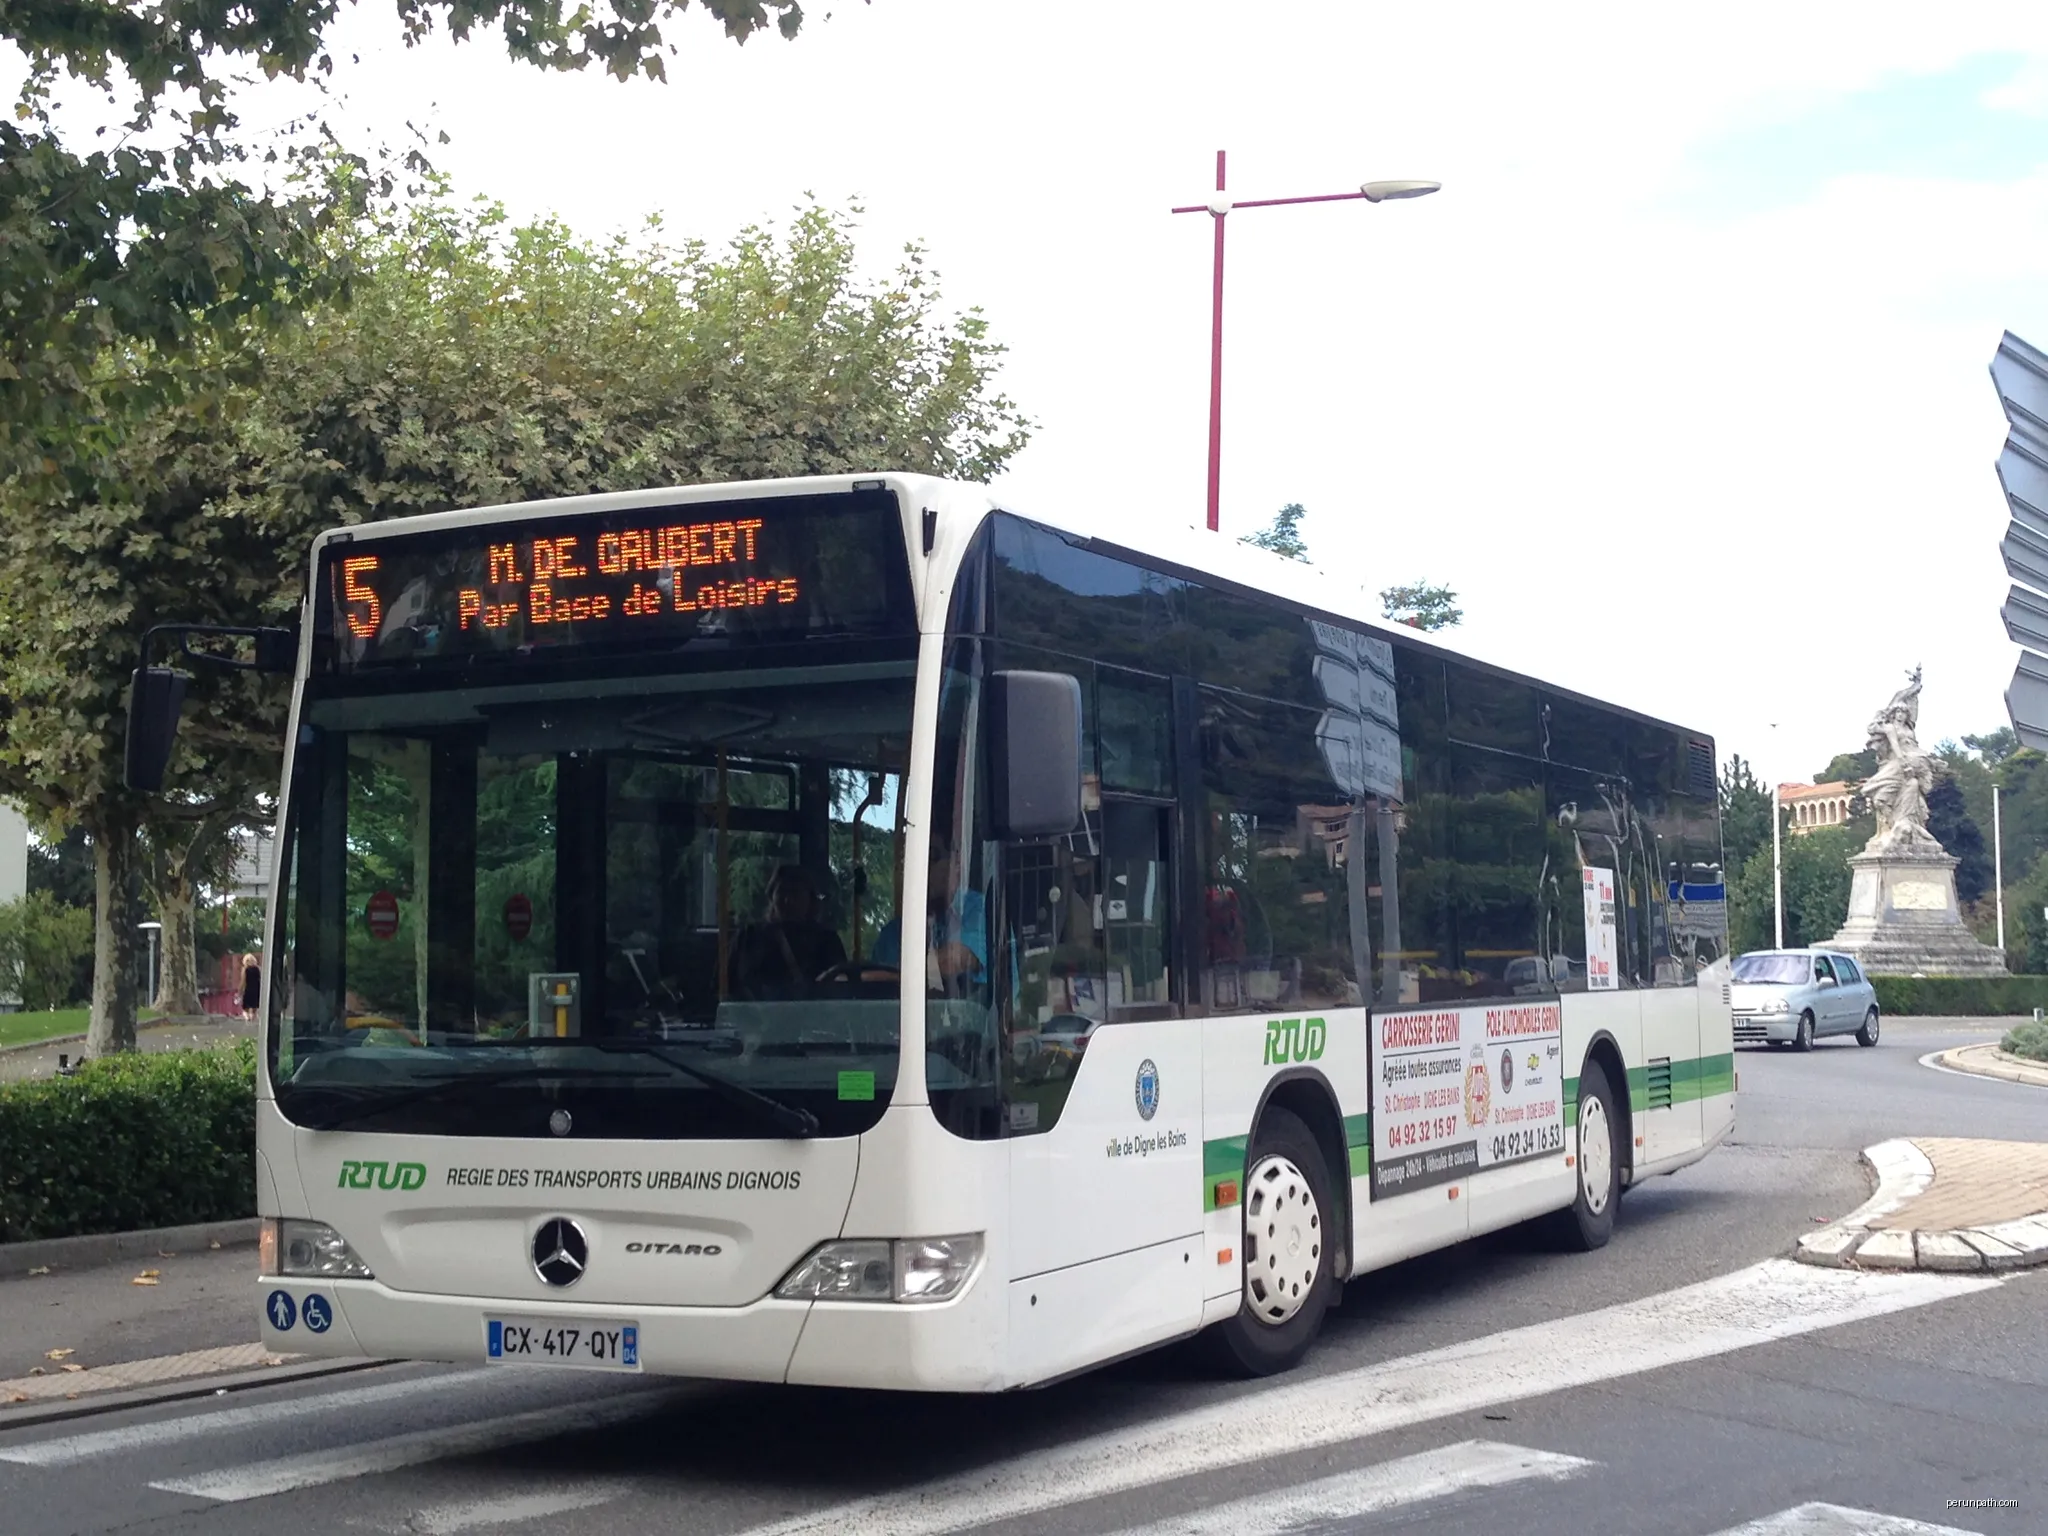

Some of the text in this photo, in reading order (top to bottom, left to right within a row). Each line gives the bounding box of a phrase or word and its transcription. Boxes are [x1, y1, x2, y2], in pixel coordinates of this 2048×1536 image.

[489, 542, 523, 583] M.
[598, 518, 762, 574] GAUBERT
[344, 556, 380, 638] 5
[459, 571, 798, 630] Par Base de Loisirs
[1382, 1012, 1460, 1049] CARROSSERIE GERINI
[1502, 1007, 1541, 1036] AUTOMOBILES
[1264, 1018, 1325, 1065] RTUD
[1382, 1058, 1461, 1088] Agréée toutes assurances
[1123, 1136, 1133, 1155] de
[1135, 1134, 1155, 1157] Digne
[1157, 1131, 1167, 1150] les
[1168, 1128, 1186, 1148] Bains
[1389, 1115, 1457, 1148] 04 92 32 15 97
[1493, 1135, 1505, 1160] 04
[1508, 1132, 1520, 1156] 92
[1523, 1129, 1533, 1153] 34
[1537, 1127, 1547, 1150] 16
[1549, 1123, 1560, 1147] 53
[338, 1161, 427, 1190] RTUD
[447, 1168, 801, 1190] REGIE DES TRANSPORTS URBAINS DIGNOIS
[625, 1242, 722, 1256] CITARO
[623, 1347, 636, 1361] 04
